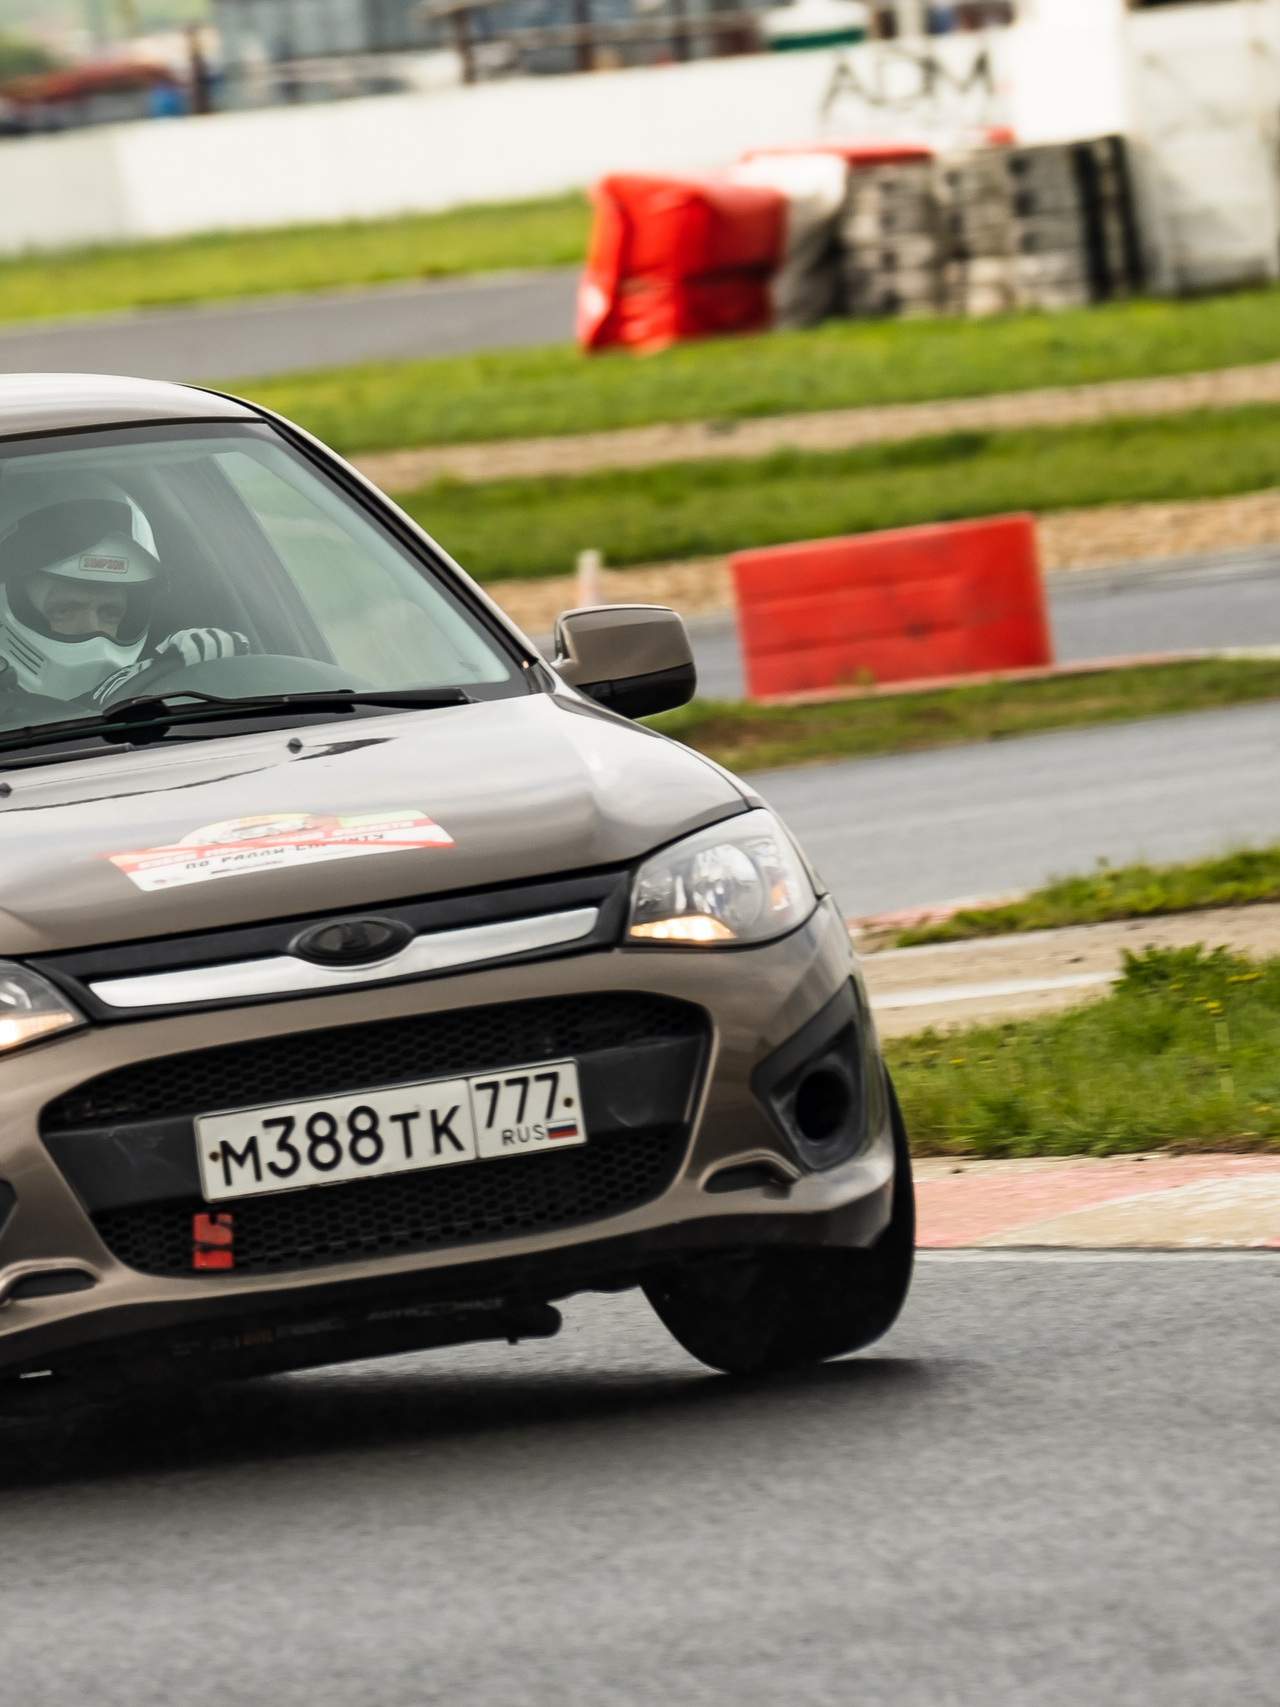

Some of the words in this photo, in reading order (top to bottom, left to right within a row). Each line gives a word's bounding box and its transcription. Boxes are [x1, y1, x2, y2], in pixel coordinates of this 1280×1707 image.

[819, 49, 996, 117] ADM
[83, 557, 125, 570] SIMPSON
[474, 1071, 561, 1129] 777
[501, 1123, 546, 1147] RUS
